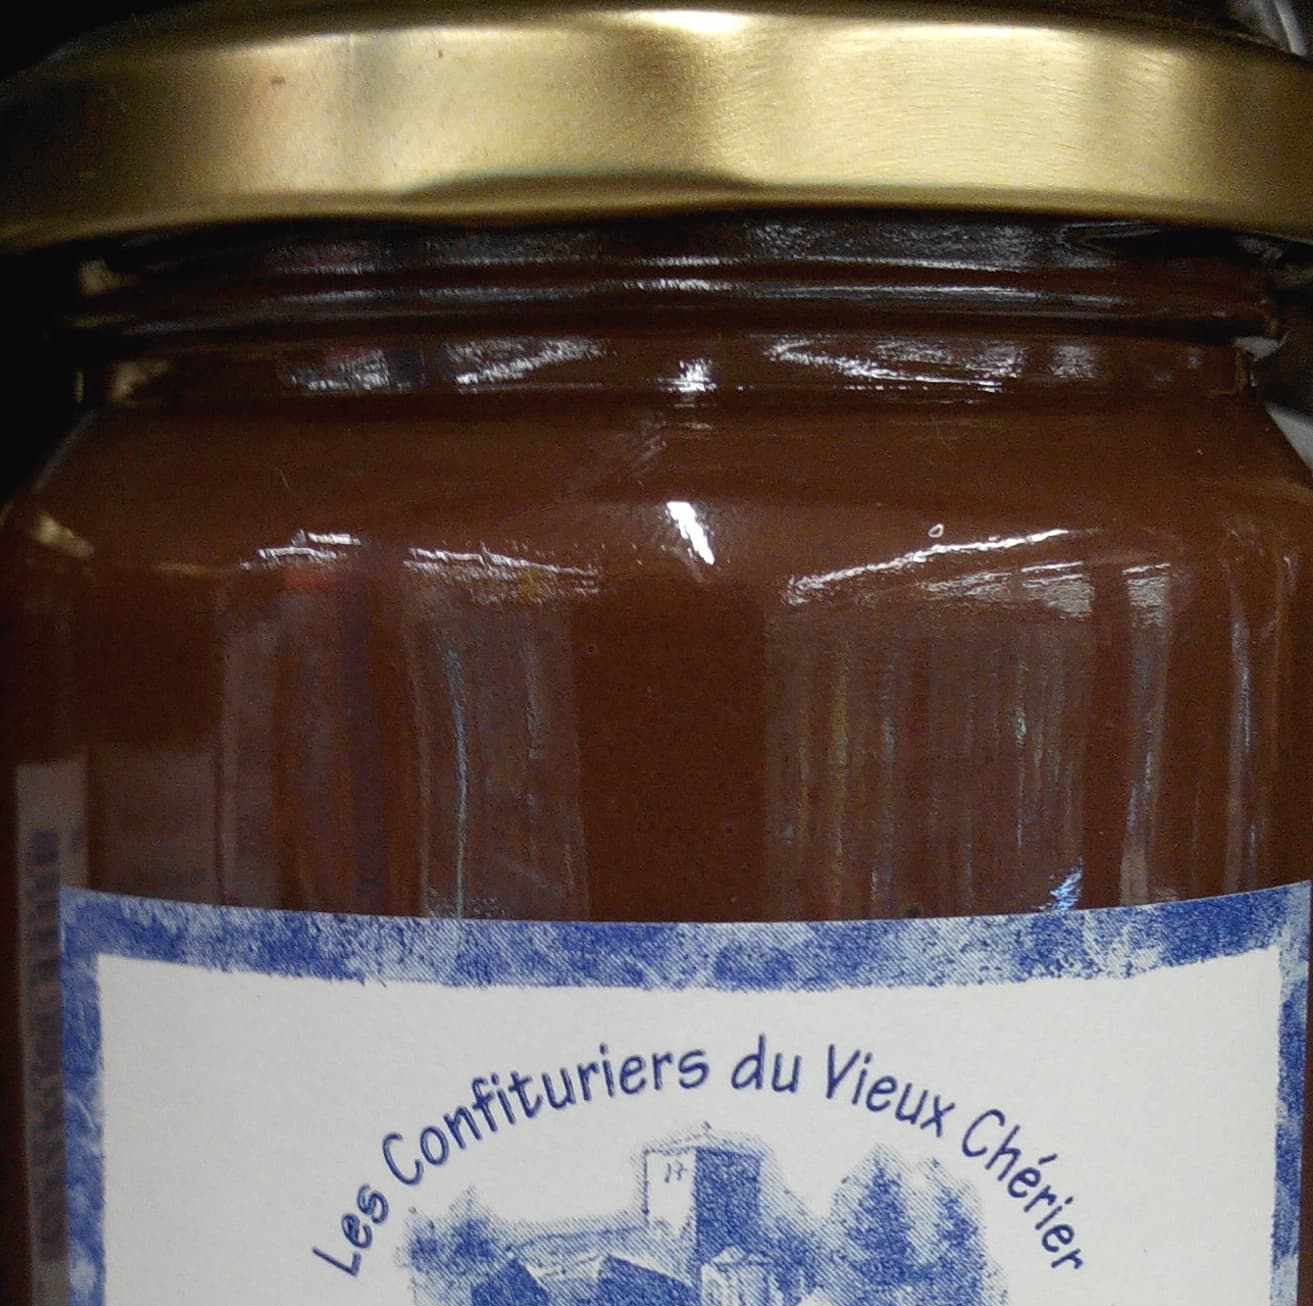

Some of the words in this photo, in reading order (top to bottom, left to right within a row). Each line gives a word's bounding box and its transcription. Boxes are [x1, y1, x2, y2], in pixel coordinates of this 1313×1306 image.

[312, 1184, 389, 1277] Les
[382, 1043, 711, 1186] Confituriers
[731, 1034, 802, 1093] du
[826, 1044, 956, 1138] Vieux
[961, 1109, 1083, 1273] Chérier
